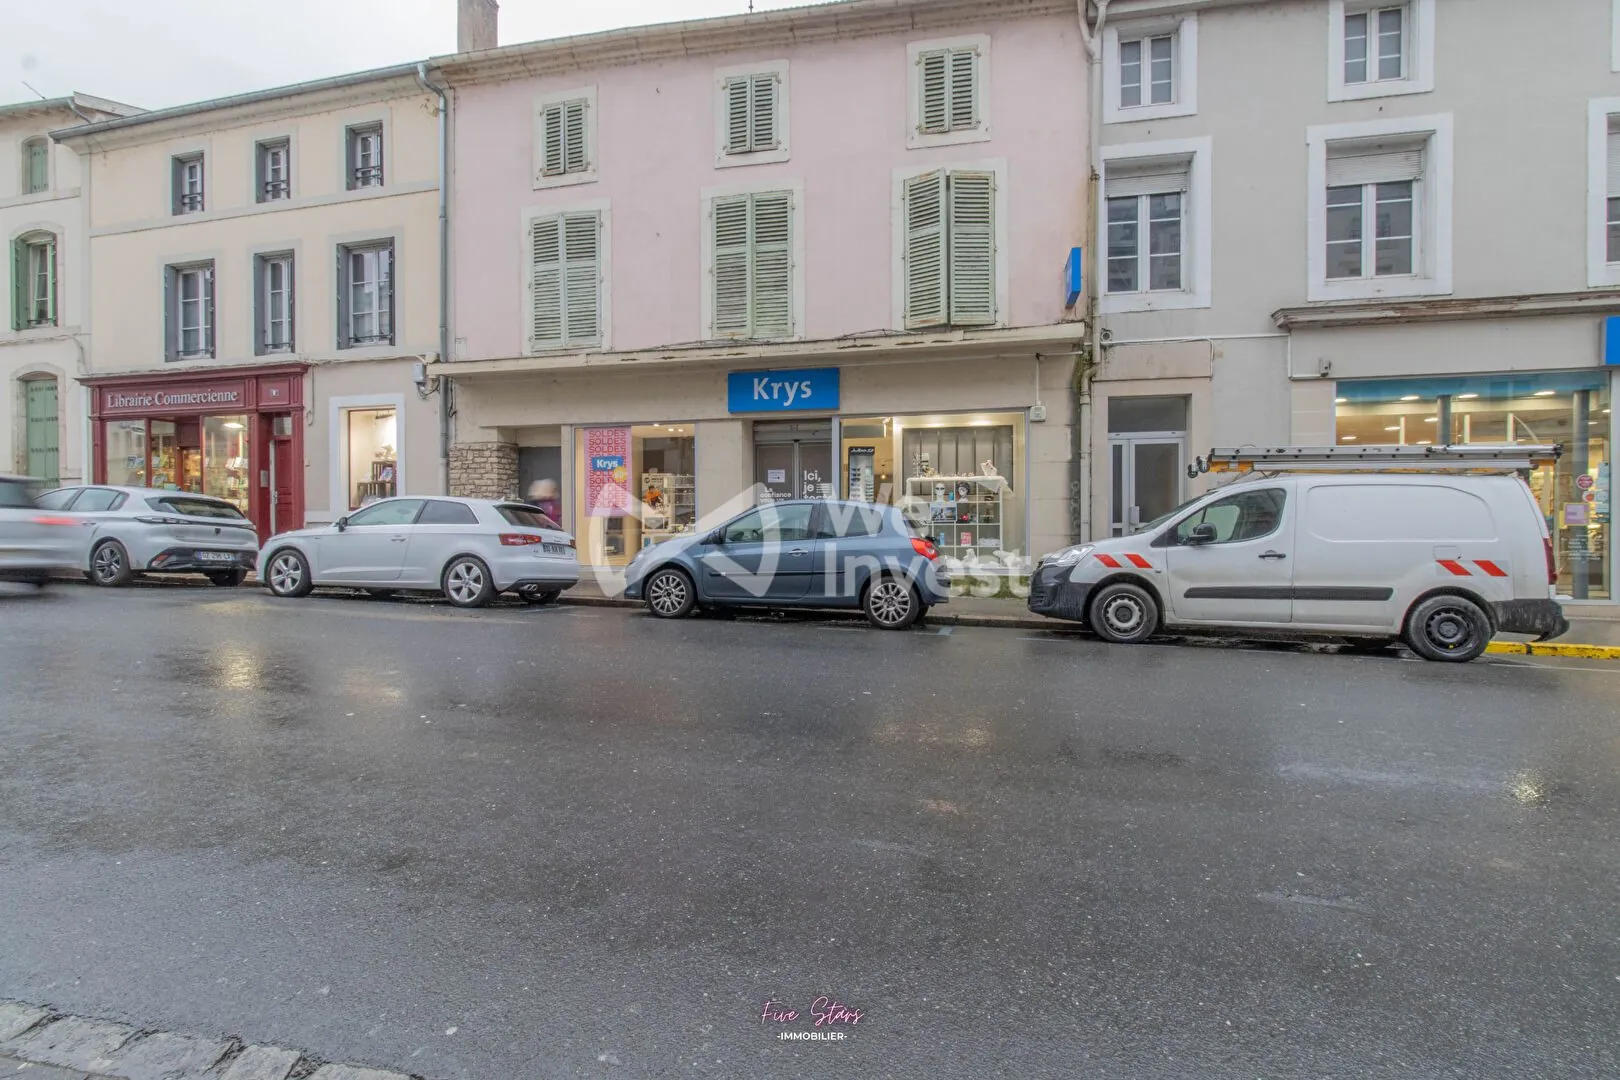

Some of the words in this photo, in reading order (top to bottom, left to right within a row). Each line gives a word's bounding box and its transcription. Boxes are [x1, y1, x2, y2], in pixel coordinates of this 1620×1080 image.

[753, 377, 812, 407] Krys
[107, 393, 152, 408] Librairie
[154, 388, 239, 405] Commercienne
[588, 429, 626, 438] SOLDES
[588, 437, 626, 446] SOLDES
[588, 445, 626, 454] SOLDES
[596, 458, 619, 469] Krys
[803, 470, 821, 482] Ici,
[803, 482, 815, 495] je
